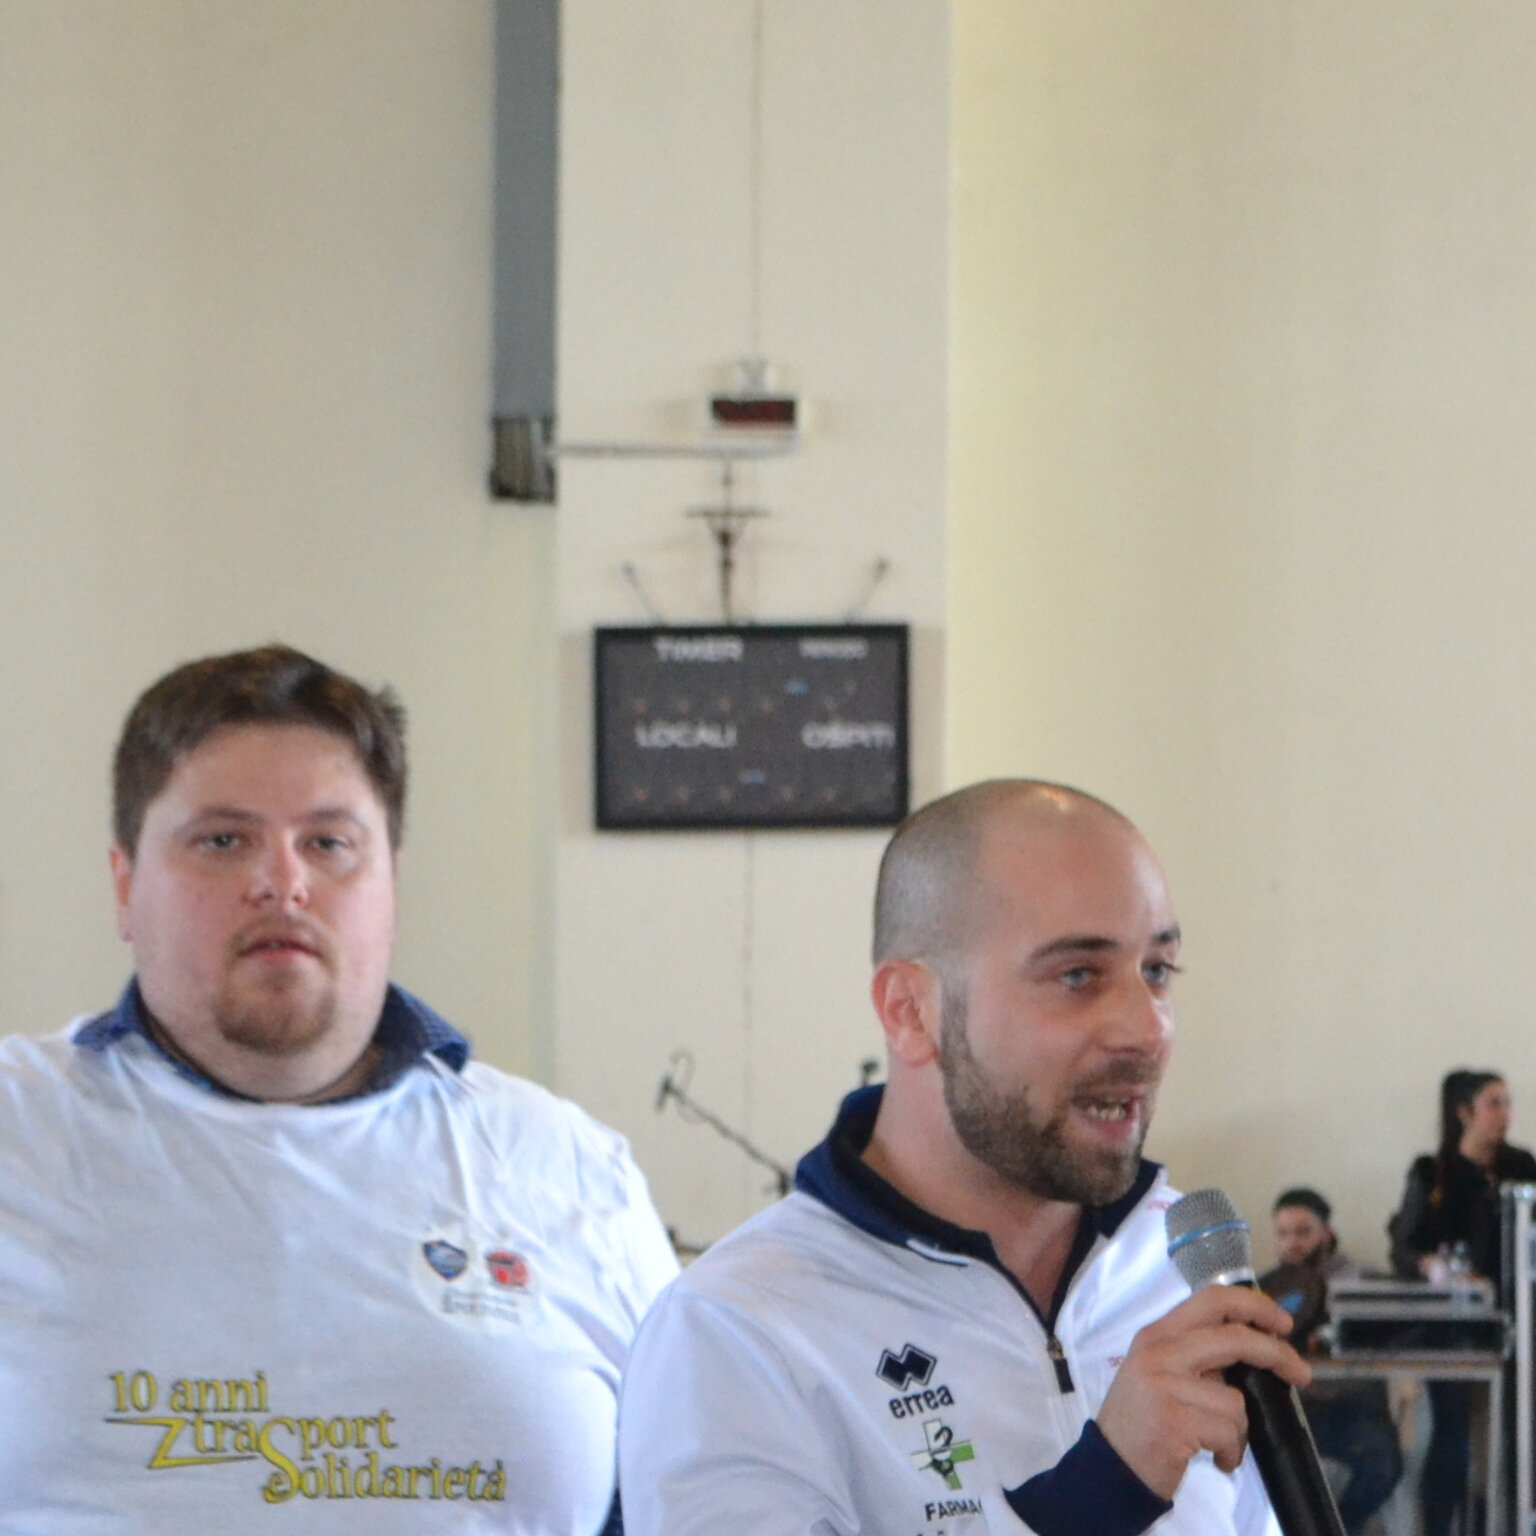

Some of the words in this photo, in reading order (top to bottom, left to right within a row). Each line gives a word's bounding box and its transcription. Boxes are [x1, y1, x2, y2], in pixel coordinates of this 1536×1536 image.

[634, 720, 737, 748] LOCALI
[108, 1371, 158, 1413] 10
[170, 1371, 269, 1413] anni
[889, 1385, 955, 1419] errea
[925, 1499, 983, 1521] FARMA
